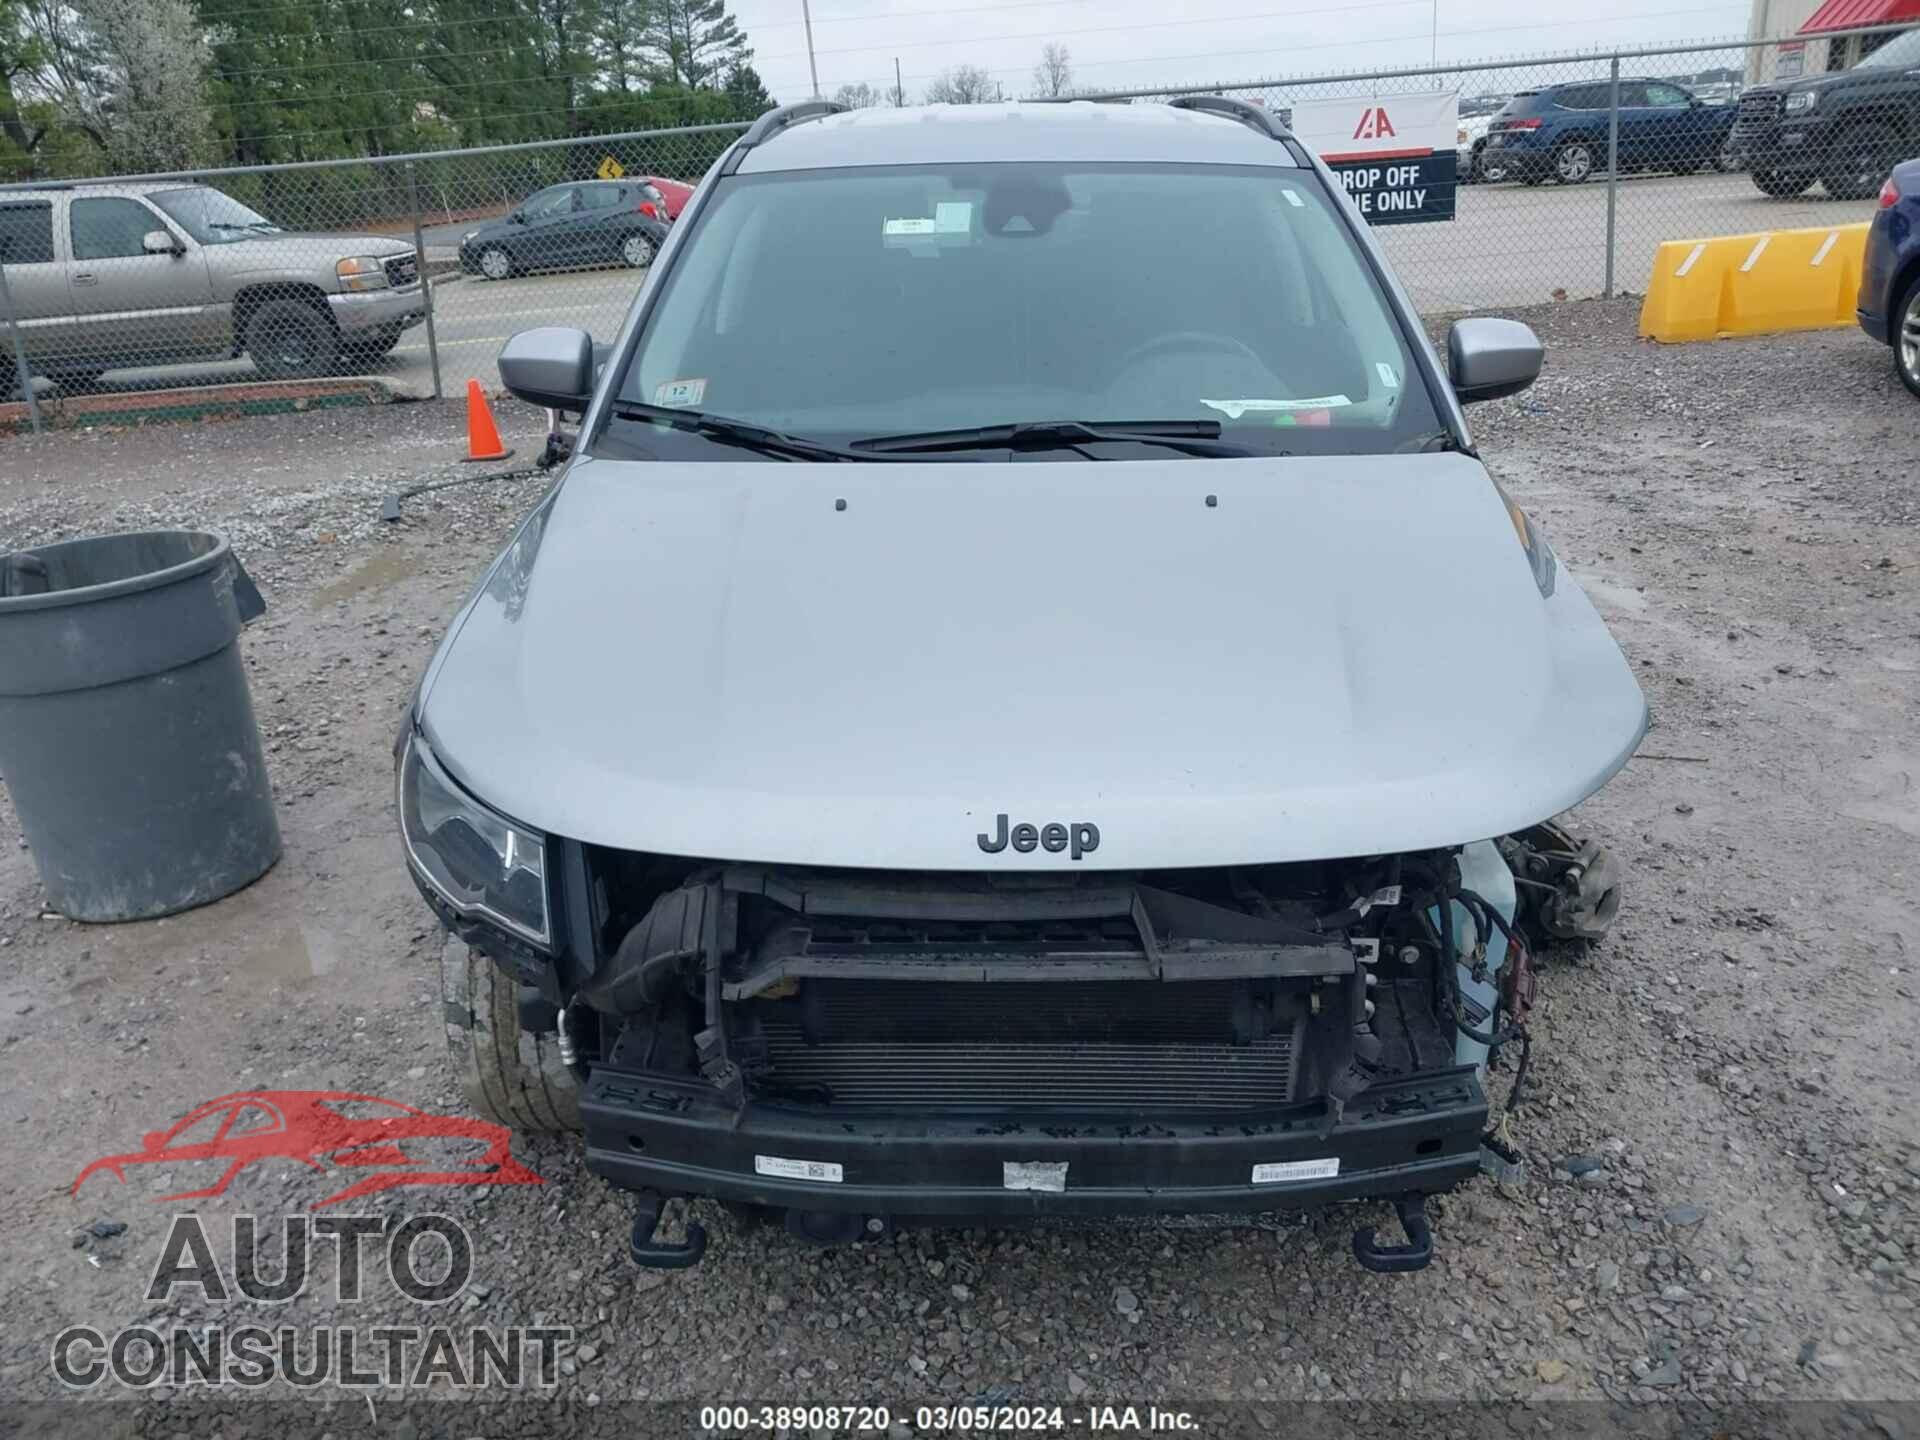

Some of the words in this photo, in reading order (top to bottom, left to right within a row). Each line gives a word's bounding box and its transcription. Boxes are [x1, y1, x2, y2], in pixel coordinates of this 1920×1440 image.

[1386, 166, 1419, 187] OFF
[1378, 189, 1426, 211] ONLY
[977, 814, 1100, 860] Jeep
